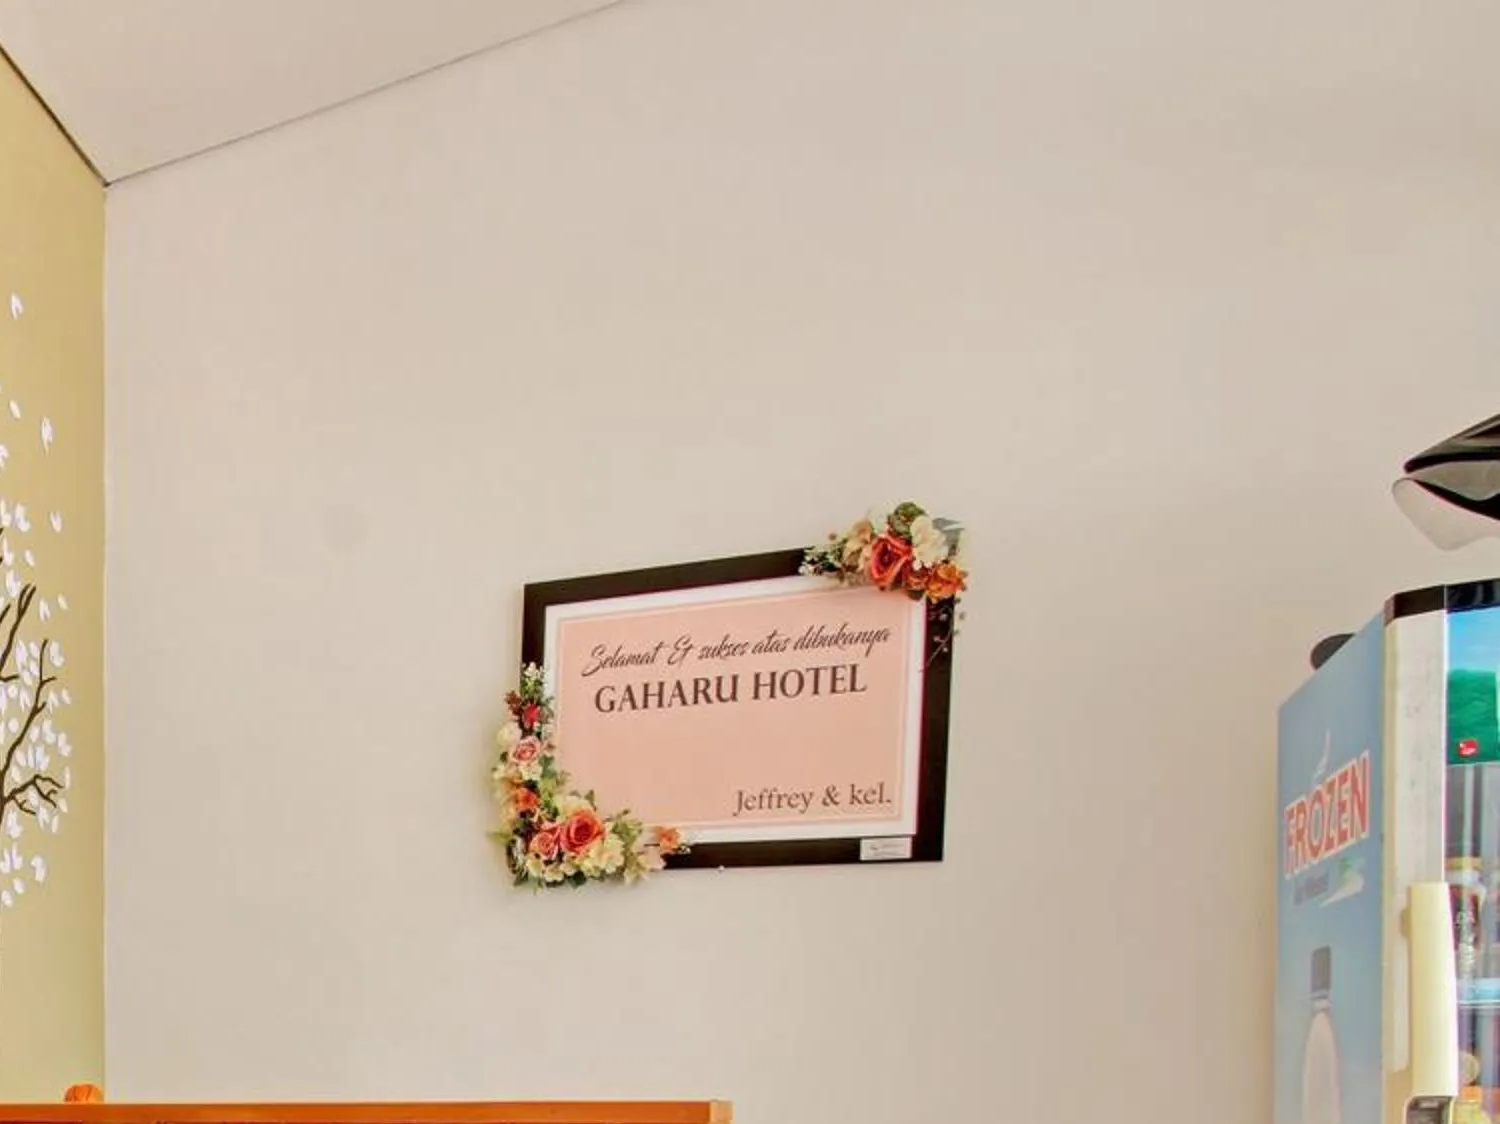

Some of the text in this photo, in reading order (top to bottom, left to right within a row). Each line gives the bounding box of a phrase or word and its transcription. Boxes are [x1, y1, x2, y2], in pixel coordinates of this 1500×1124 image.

[580, 641, 665, 678] Selamat
[697, 633, 750, 661] sukses
[751, 629, 792, 655] atas
[792, 621, 891, 659] dibukanya
[594, 663, 868, 714] GAHARU HOTEL
[732, 781, 893, 818] Jeffrey & kel.
[1283, 750, 1370, 880] FROZEN
